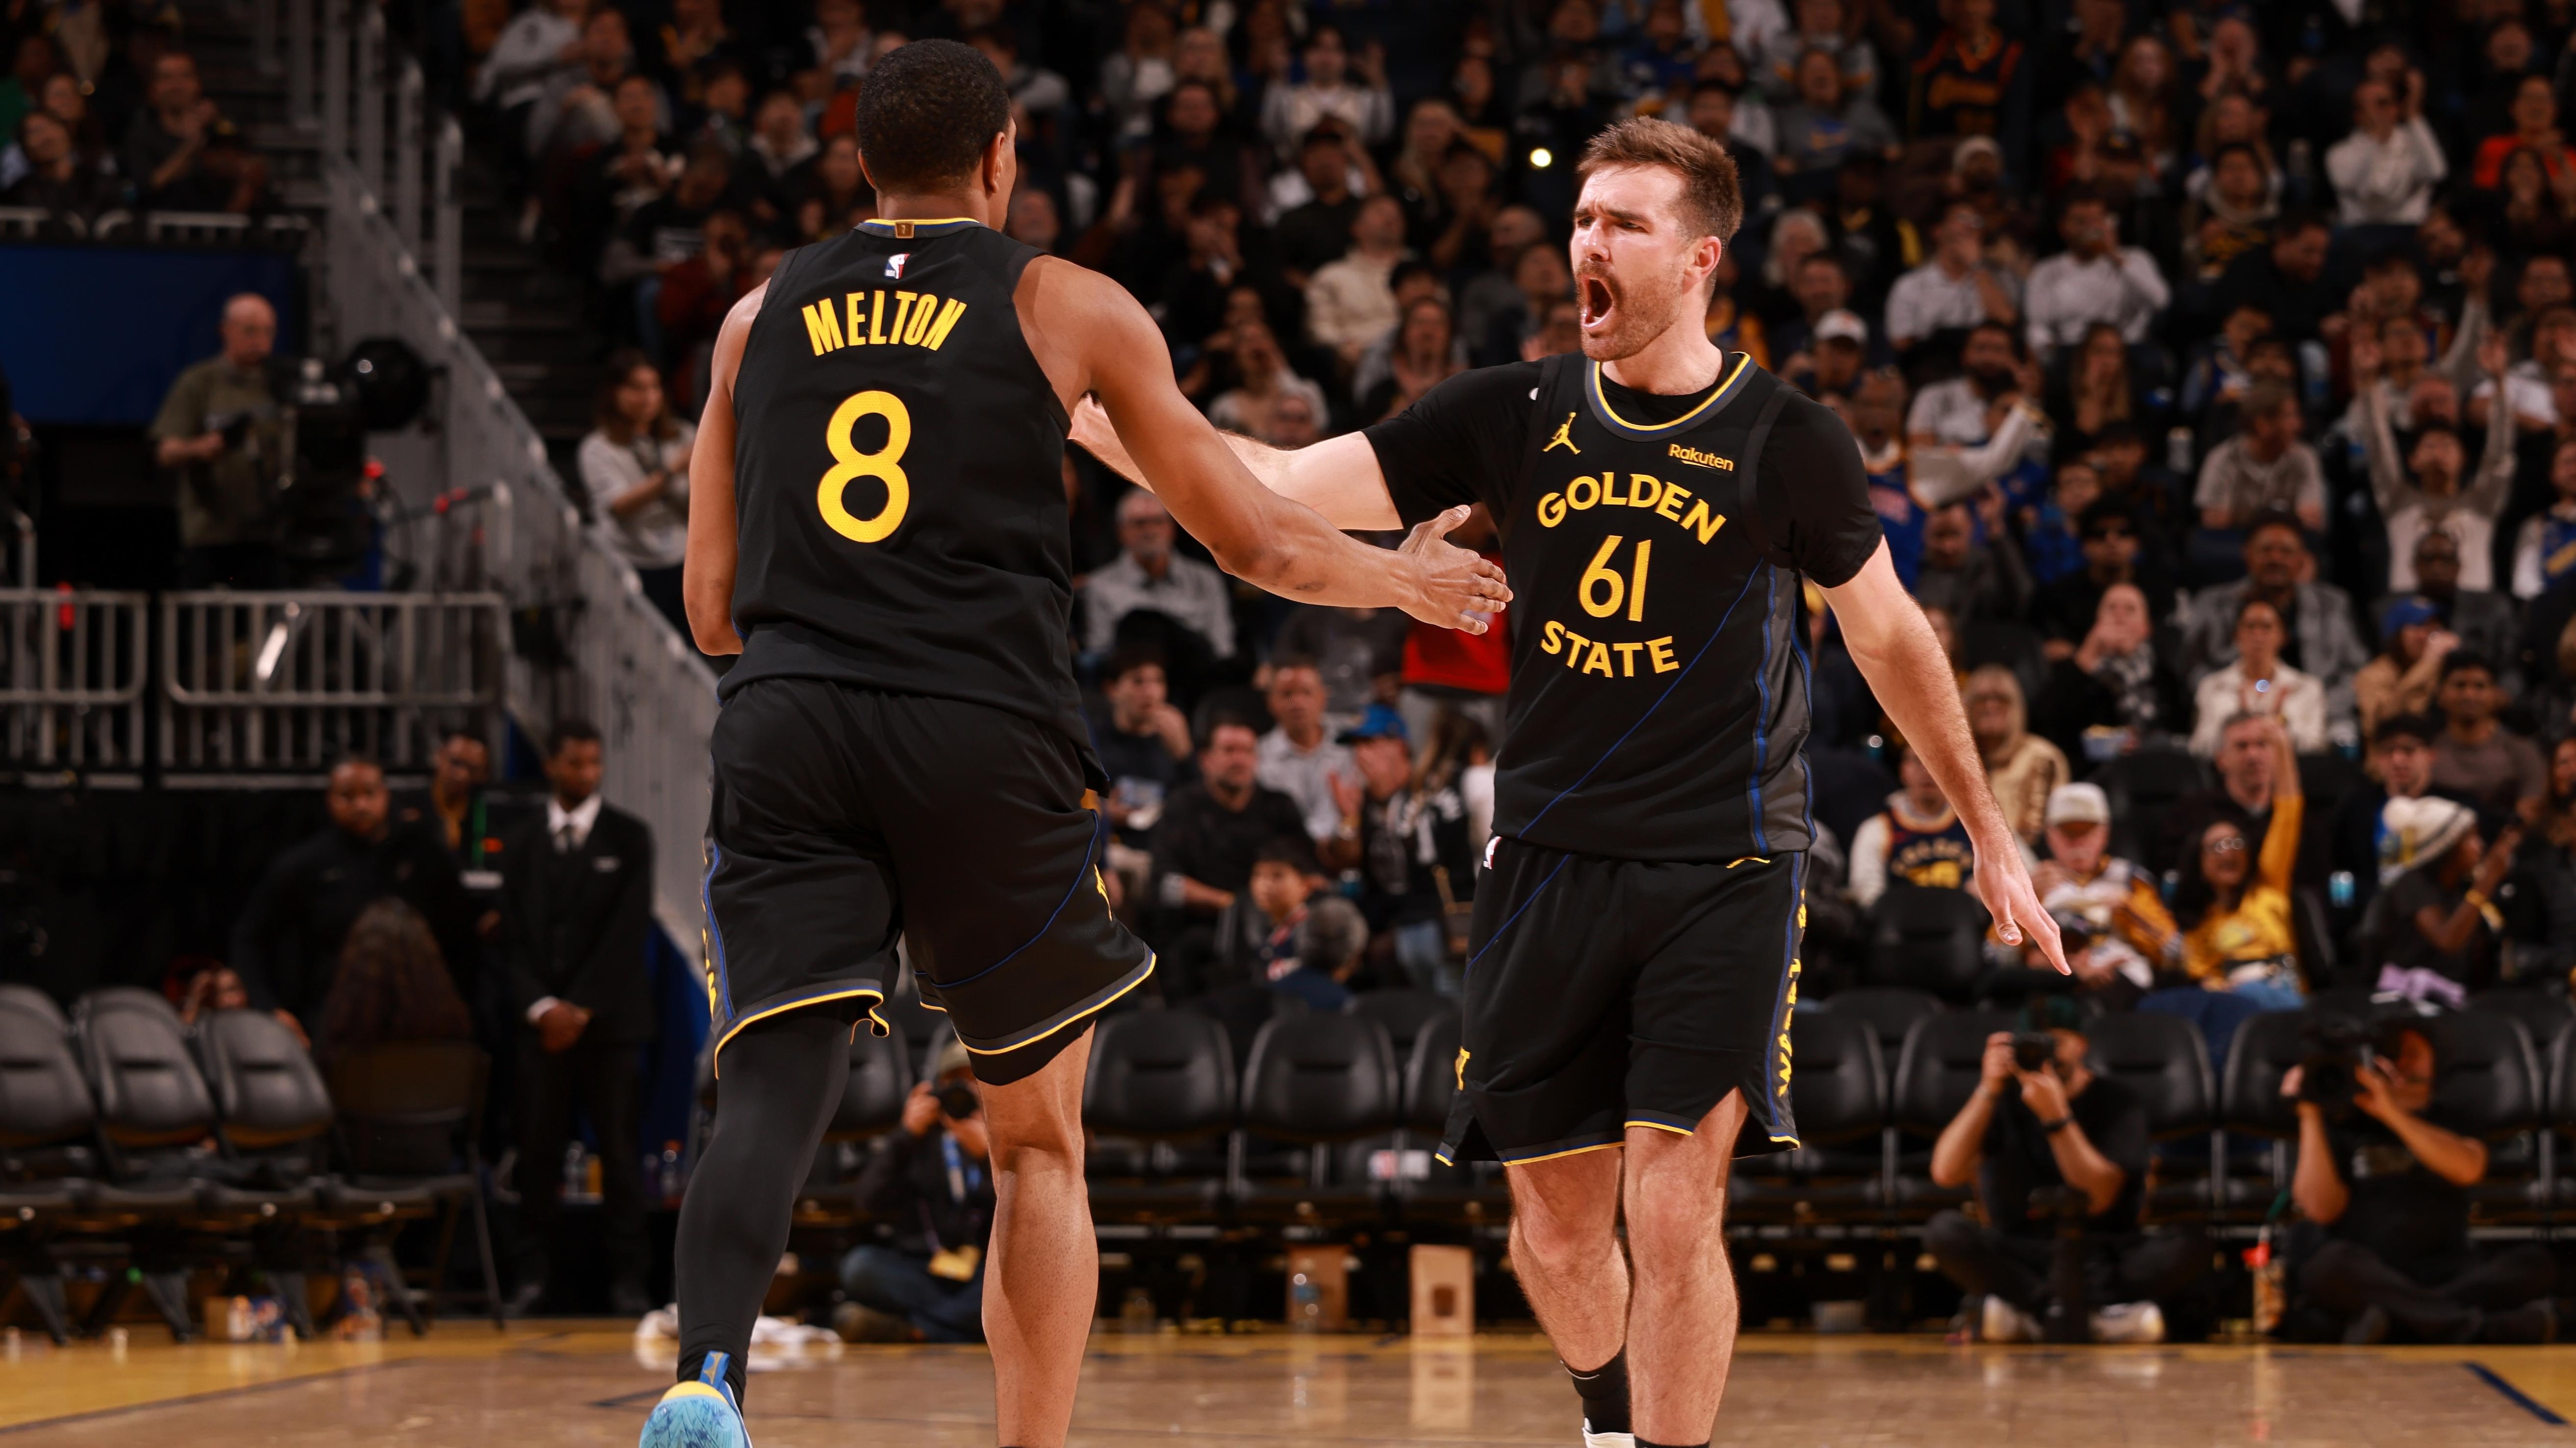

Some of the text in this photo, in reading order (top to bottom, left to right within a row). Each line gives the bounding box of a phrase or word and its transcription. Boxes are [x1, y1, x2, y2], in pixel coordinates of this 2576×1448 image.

[802, 291, 967, 356] MELTON
[817, 390, 911, 543] 8
[1668, 443, 1734, 472] Rakuten
[1537, 471, 1727, 545] GOLDEN
[1578, 535, 1652, 622] 61
[1540, 620, 1680, 678] STATE
